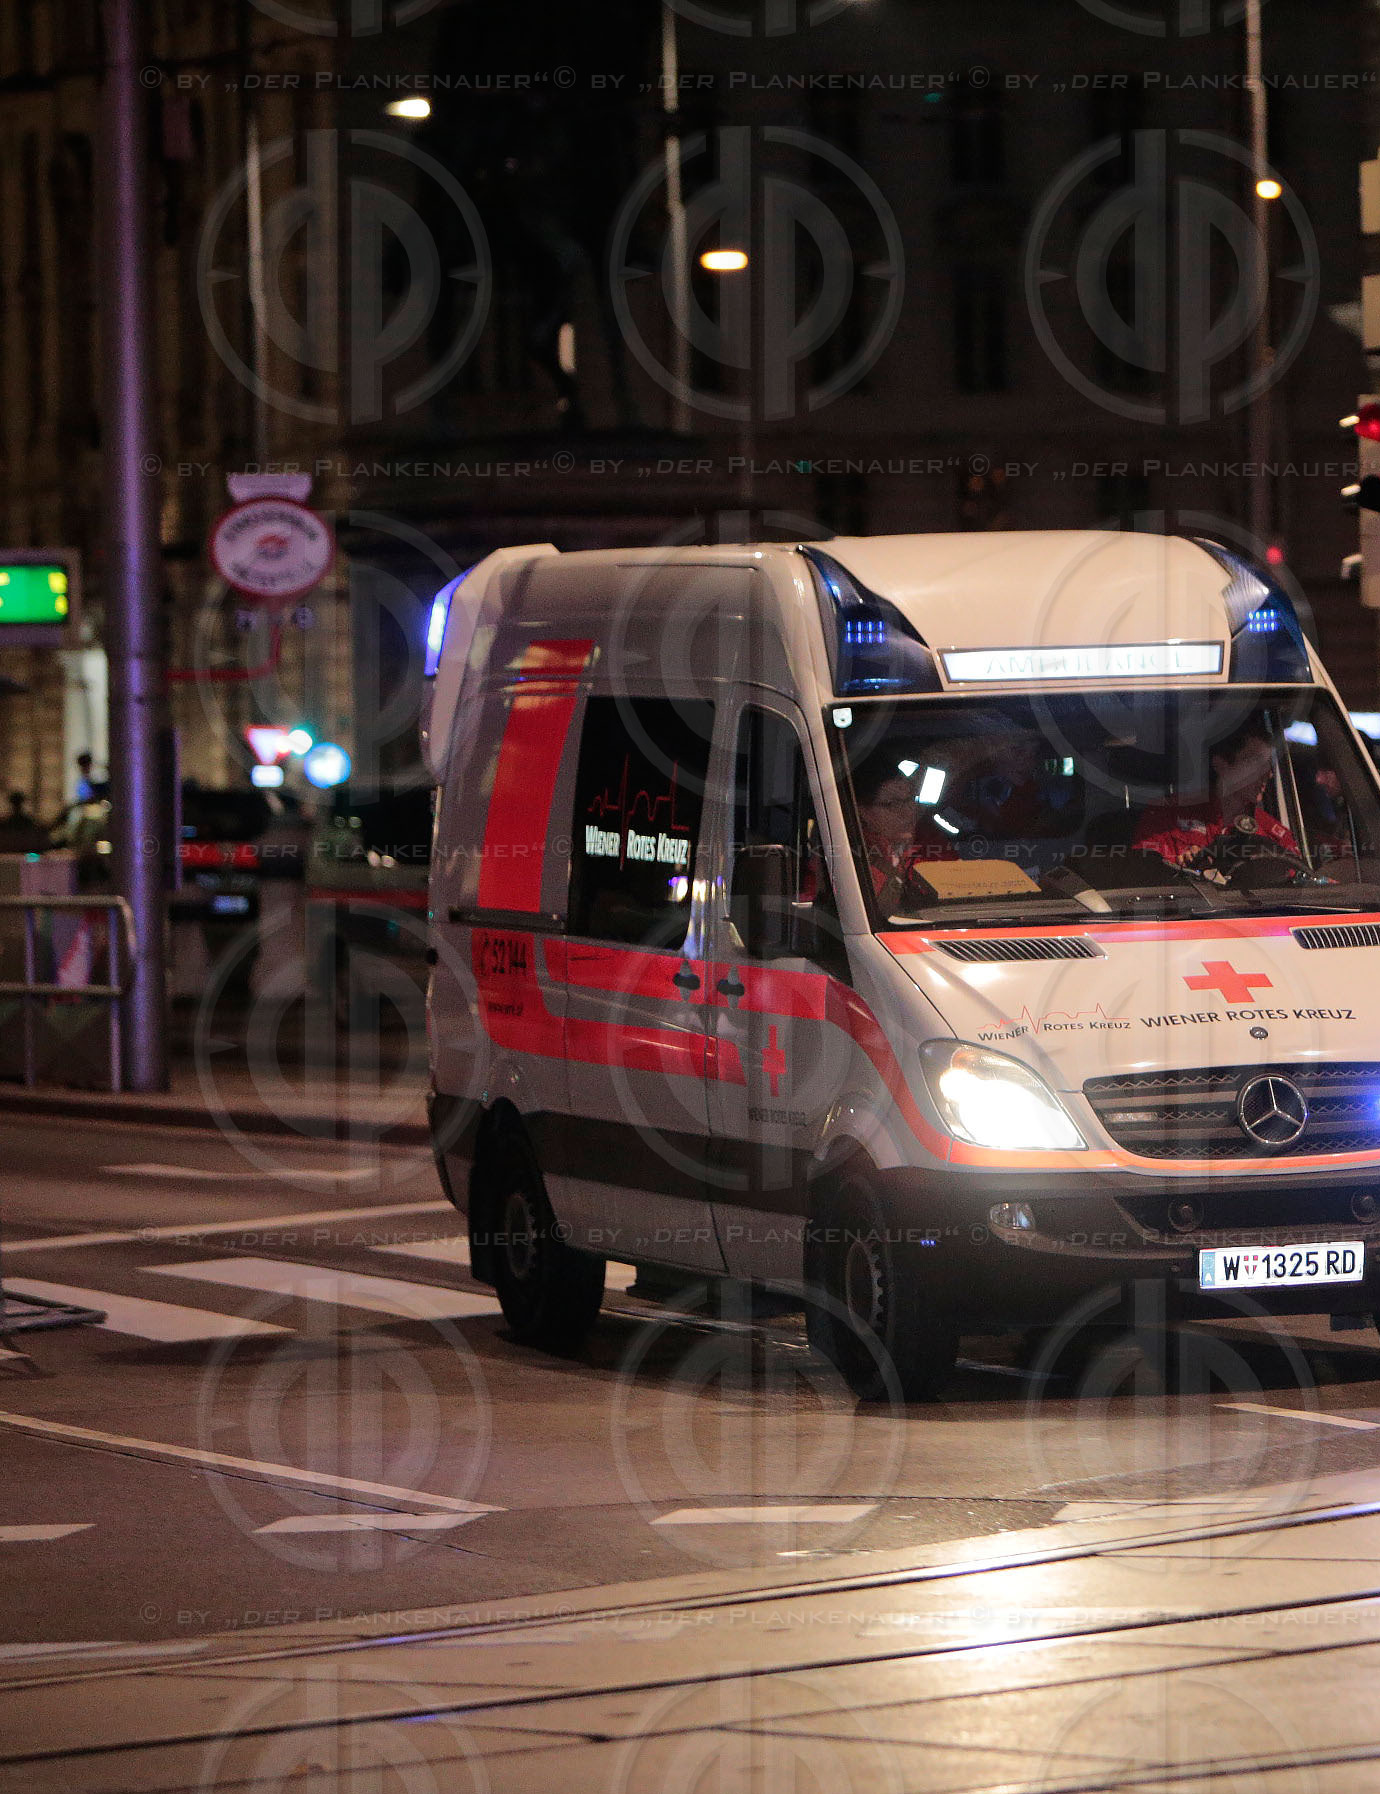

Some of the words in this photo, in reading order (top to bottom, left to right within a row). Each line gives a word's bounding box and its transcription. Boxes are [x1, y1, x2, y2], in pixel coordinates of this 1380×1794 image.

[585, 825, 620, 857] WIENER
[627, 829, 656, 862] ROTES
[656, 833, 689, 865] KREUZ
[978, 1025, 1029, 1041] WIENER
[1043, 1023, 1084, 1031] ROTES
[1089, 1021, 1131, 1030] KREUZ
[1140, 1011, 1221, 1028] WIENER
[1224, 1009, 1288, 1021] ROTES
[1292, 1009, 1357, 1020] KREUZ
[1223, 1255, 1240, 1280] W
[1261, 1251, 1319, 1279] 1325
[1326, 1250, 1356, 1275] RD
